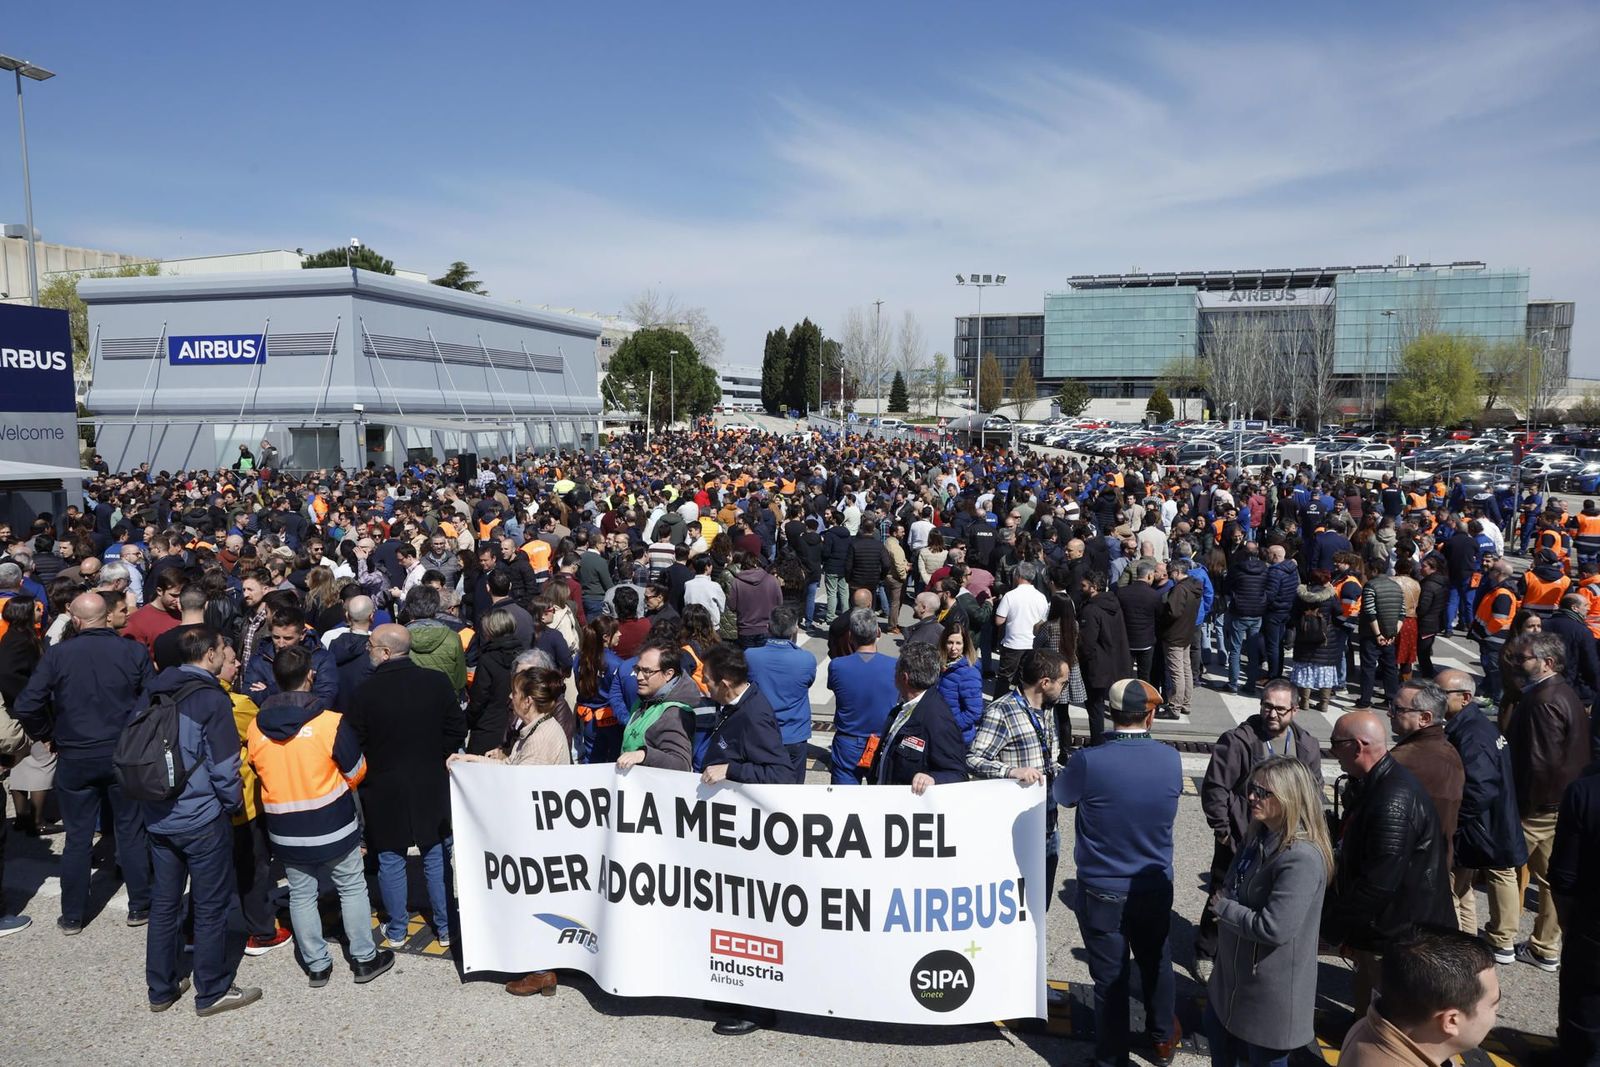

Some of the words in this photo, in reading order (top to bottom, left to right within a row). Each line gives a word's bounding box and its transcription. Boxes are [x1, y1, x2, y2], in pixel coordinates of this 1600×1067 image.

[1228, 289, 1297, 303] AIRBUS
[0, 348, 67, 371] RBUS
[178, 339, 257, 360] AIRBUS
[531, 787, 612, 831] ¡POR
[616, 789, 664, 835] LA
[674, 796, 873, 859] MEJORA
[884, 813, 957, 858] DEL
[484, 850, 592, 895] PODER
[597, 854, 809, 928] ADQUISITIVO
[821, 887, 871, 932] EN
[883, 877, 1026, 933] AIRBUS!
[714, 933, 779, 960] CCOO
[710, 956, 784, 983] industria
[710, 973, 745, 987] Airbus
[916, 968, 969, 990] SIPA
